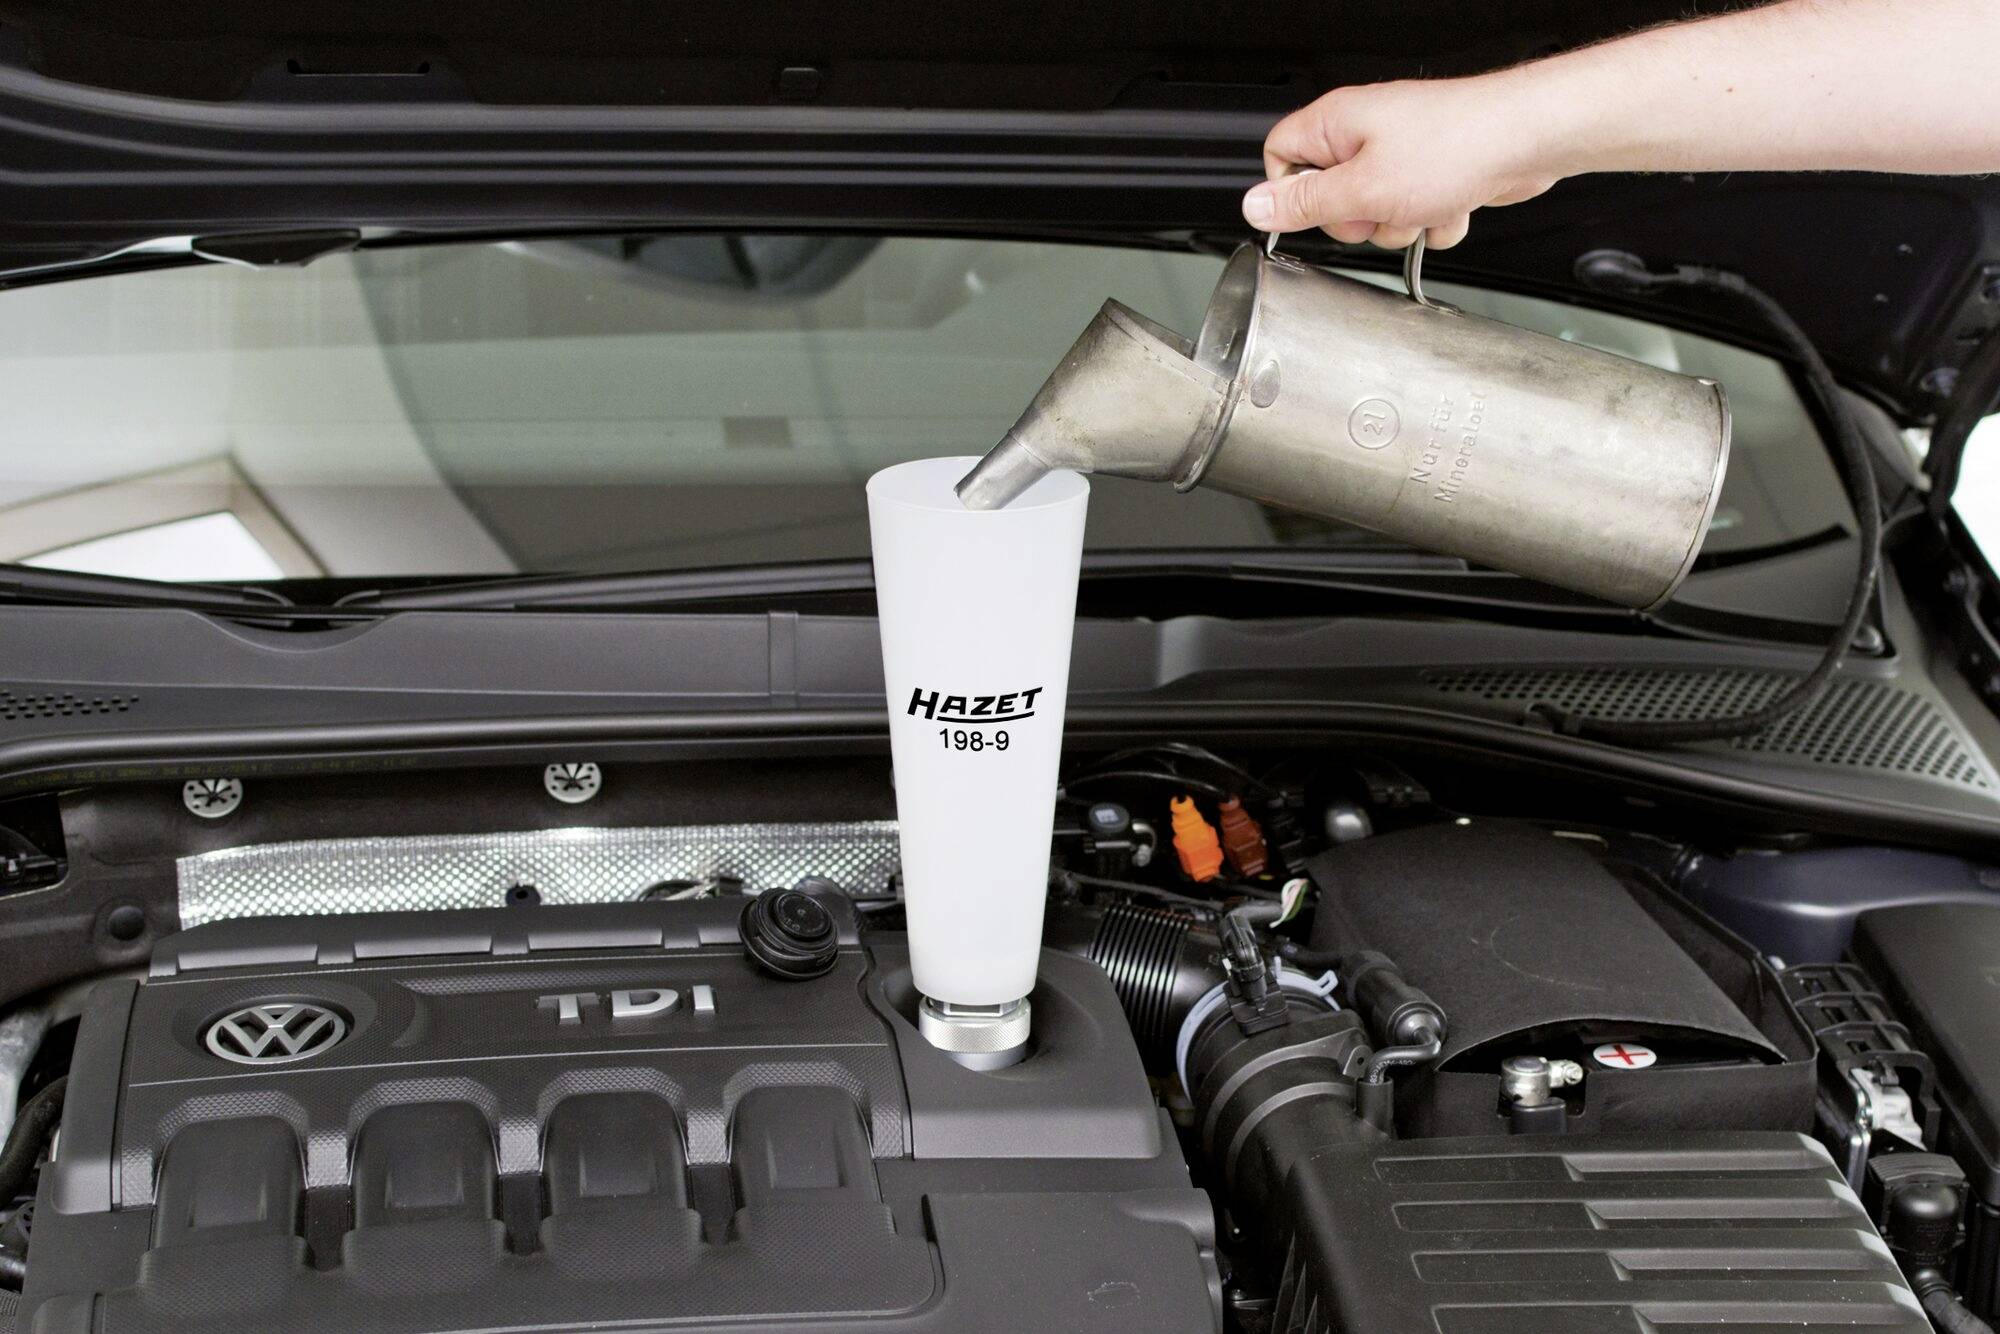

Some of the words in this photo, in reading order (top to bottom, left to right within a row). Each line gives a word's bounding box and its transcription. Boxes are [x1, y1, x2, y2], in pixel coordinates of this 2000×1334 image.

[1409, 439, 1442, 484] Nur
[1430, 393, 1455, 433] für
[1433, 392, 1488, 503] Mineraloel
[907, 687, 1043, 721] HAZET
[939, 728, 1010, 751] 198-9
[534, 984, 716, 1024] TDI
